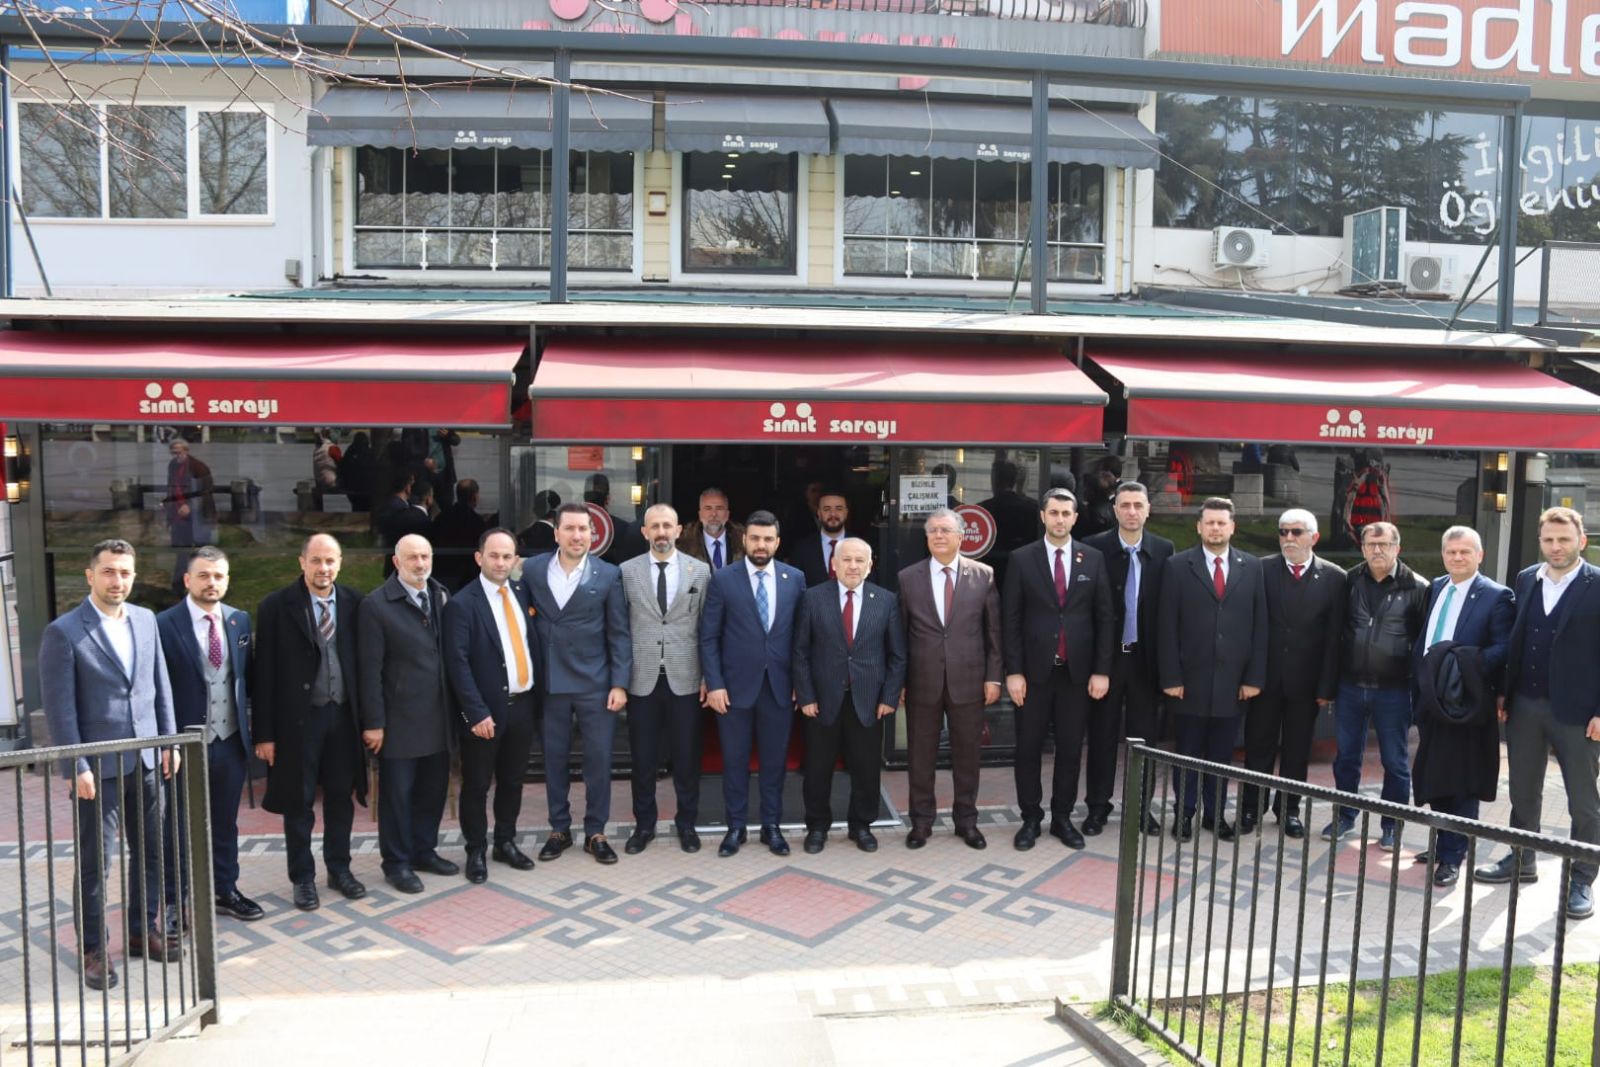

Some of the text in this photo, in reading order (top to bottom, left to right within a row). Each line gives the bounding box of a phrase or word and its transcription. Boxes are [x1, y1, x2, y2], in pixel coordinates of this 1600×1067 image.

[1281, 0, 1600, 76] madl
[139, 382, 195, 414] simit
[763, 402, 817, 433] simit
[1319, 409, 1366, 438] simit
